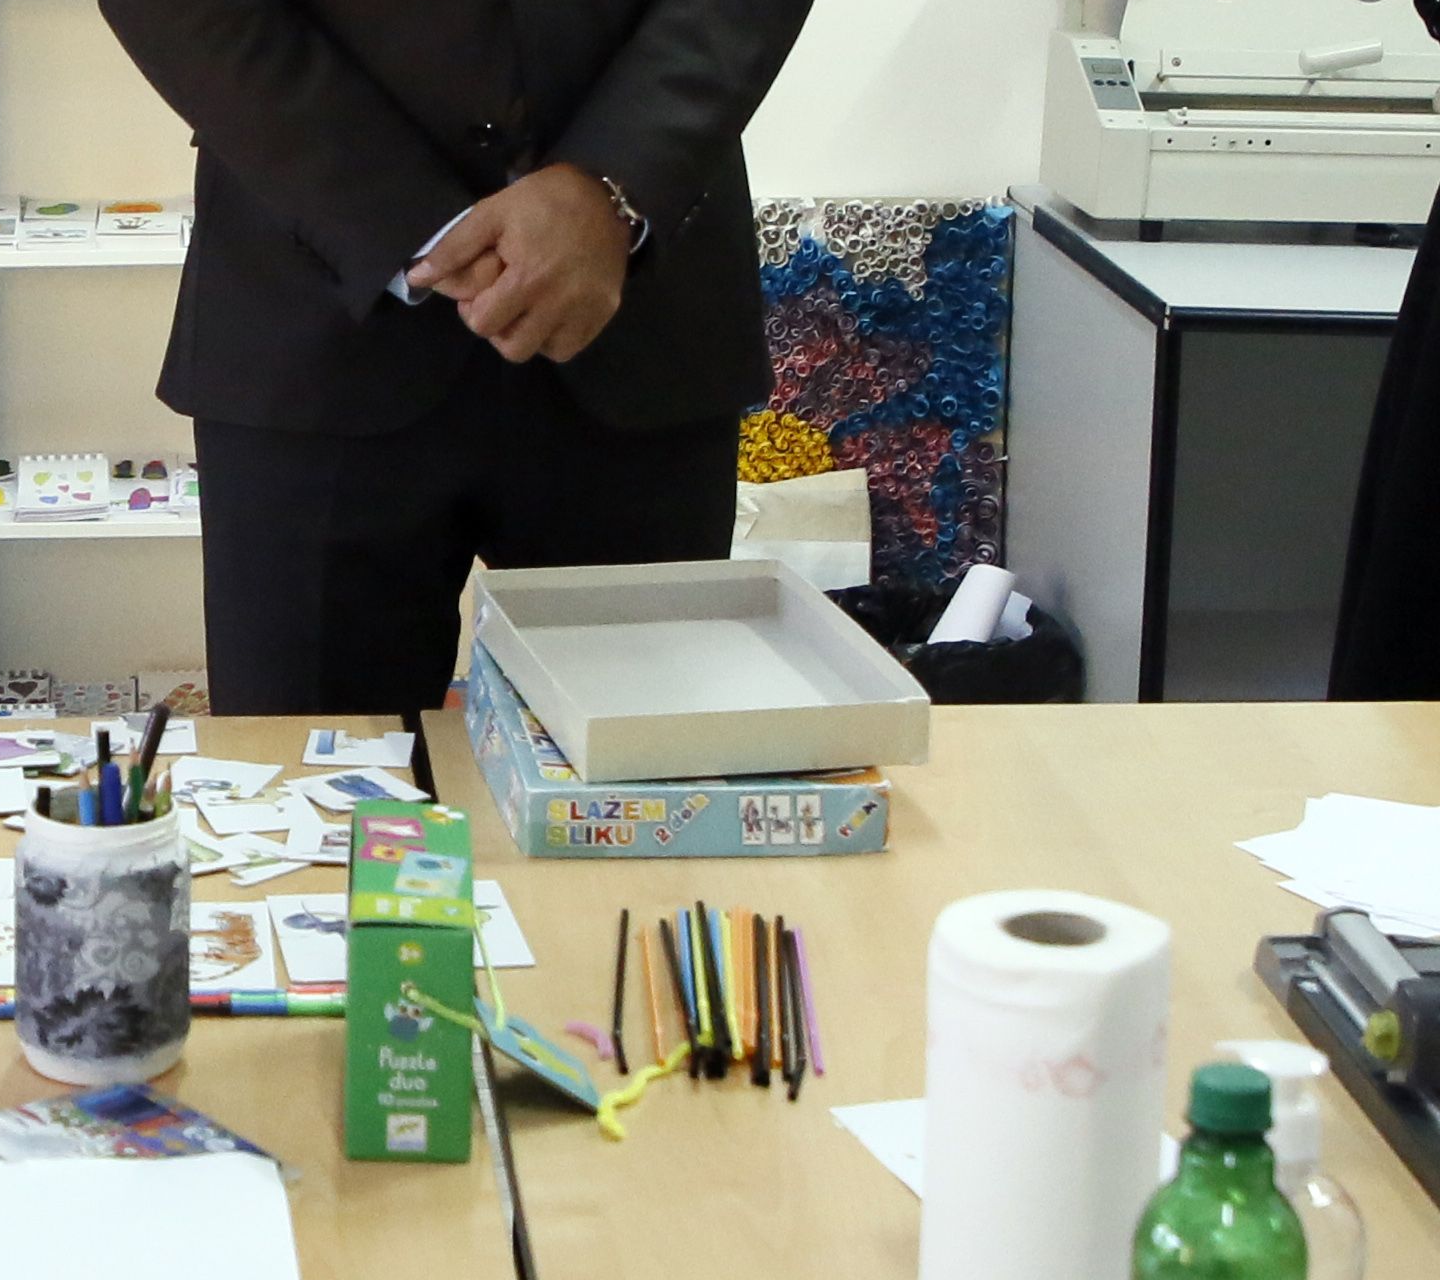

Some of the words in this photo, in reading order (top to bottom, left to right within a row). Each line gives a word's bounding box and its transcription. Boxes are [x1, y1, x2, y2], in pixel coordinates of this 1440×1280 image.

[546, 794, 668, 822] SLAŽEM
[545, 822, 635, 848] SLIKU
[378, 1045, 439, 1074] Puzzle
[388, 1070, 428, 1092] duo
